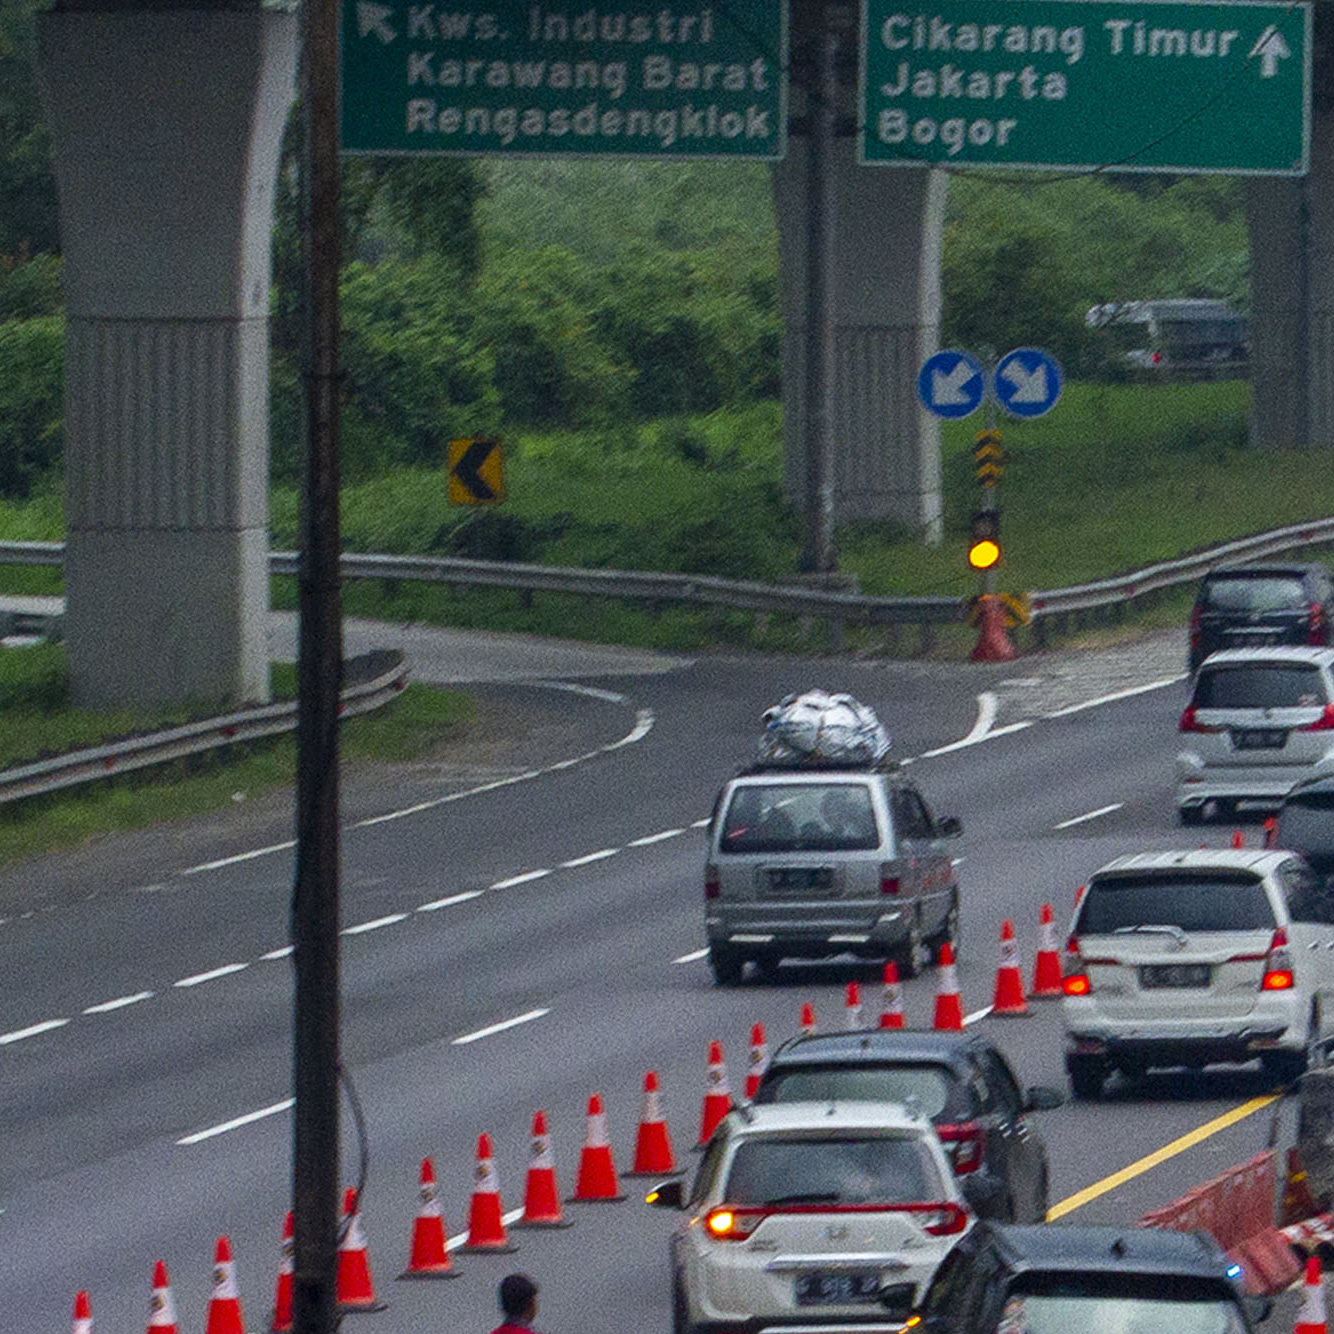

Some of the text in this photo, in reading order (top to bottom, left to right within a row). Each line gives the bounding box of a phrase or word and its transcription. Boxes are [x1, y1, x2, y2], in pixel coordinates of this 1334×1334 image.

[407, 5, 715, 43] Kws. Industri
[880, 13, 1240, 65] Cikarang Timur
[406, 51, 769, 98] Karawang Barat
[880, 61, 1067, 99] Jakarta
[405, 98, 769, 146] Rengasdengklok
[877, 107, 1018, 155] Bogor
